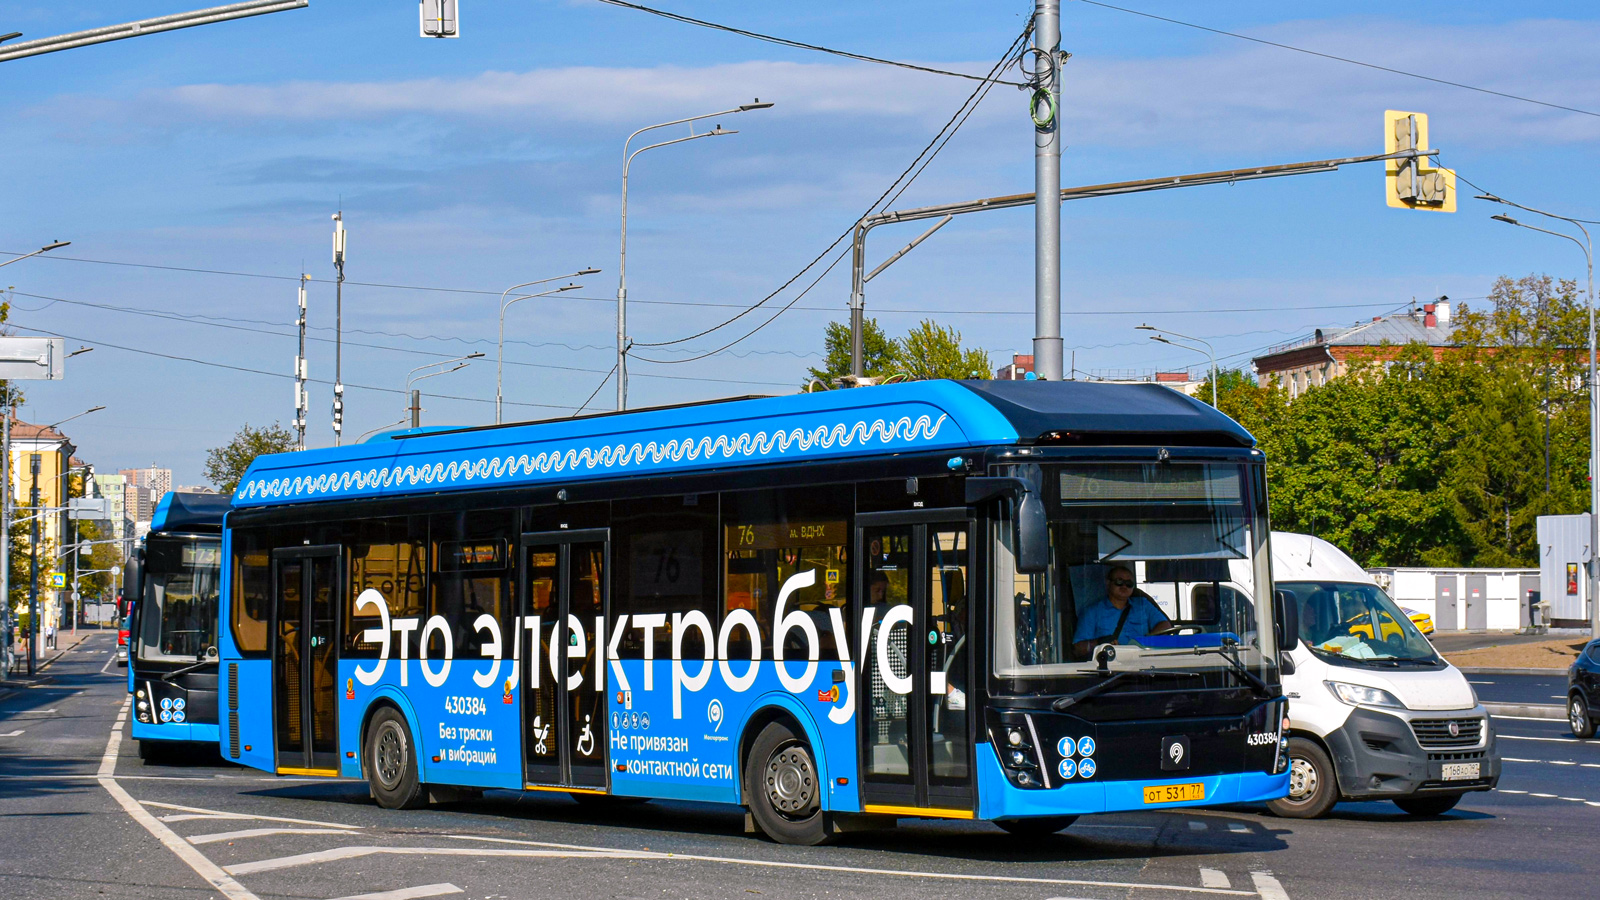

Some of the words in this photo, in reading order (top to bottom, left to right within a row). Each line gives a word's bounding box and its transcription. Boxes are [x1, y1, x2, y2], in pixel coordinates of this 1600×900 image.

[738, 524, 755, 546] 76
[801, 525, 825, 539] ВДНХ
[354, 587, 452, 688] Это
[445, 695, 487, 715] 430384
[439, 722, 456, 740] Без
[458, 727, 493, 744] тряски
[610, 729, 628, 750] Не
[630, 735, 689, 755] привязан
[1247, 731, 1278, 746] 430384
[440, 748, 446, 761] и
[448, 744, 497, 767] вибраций
[626, 757, 700, 778] контактной
[702, 762, 733, 780] сети
[1166, 786, 1185, 800] 531
[1191, 784, 1201, 795] 77
